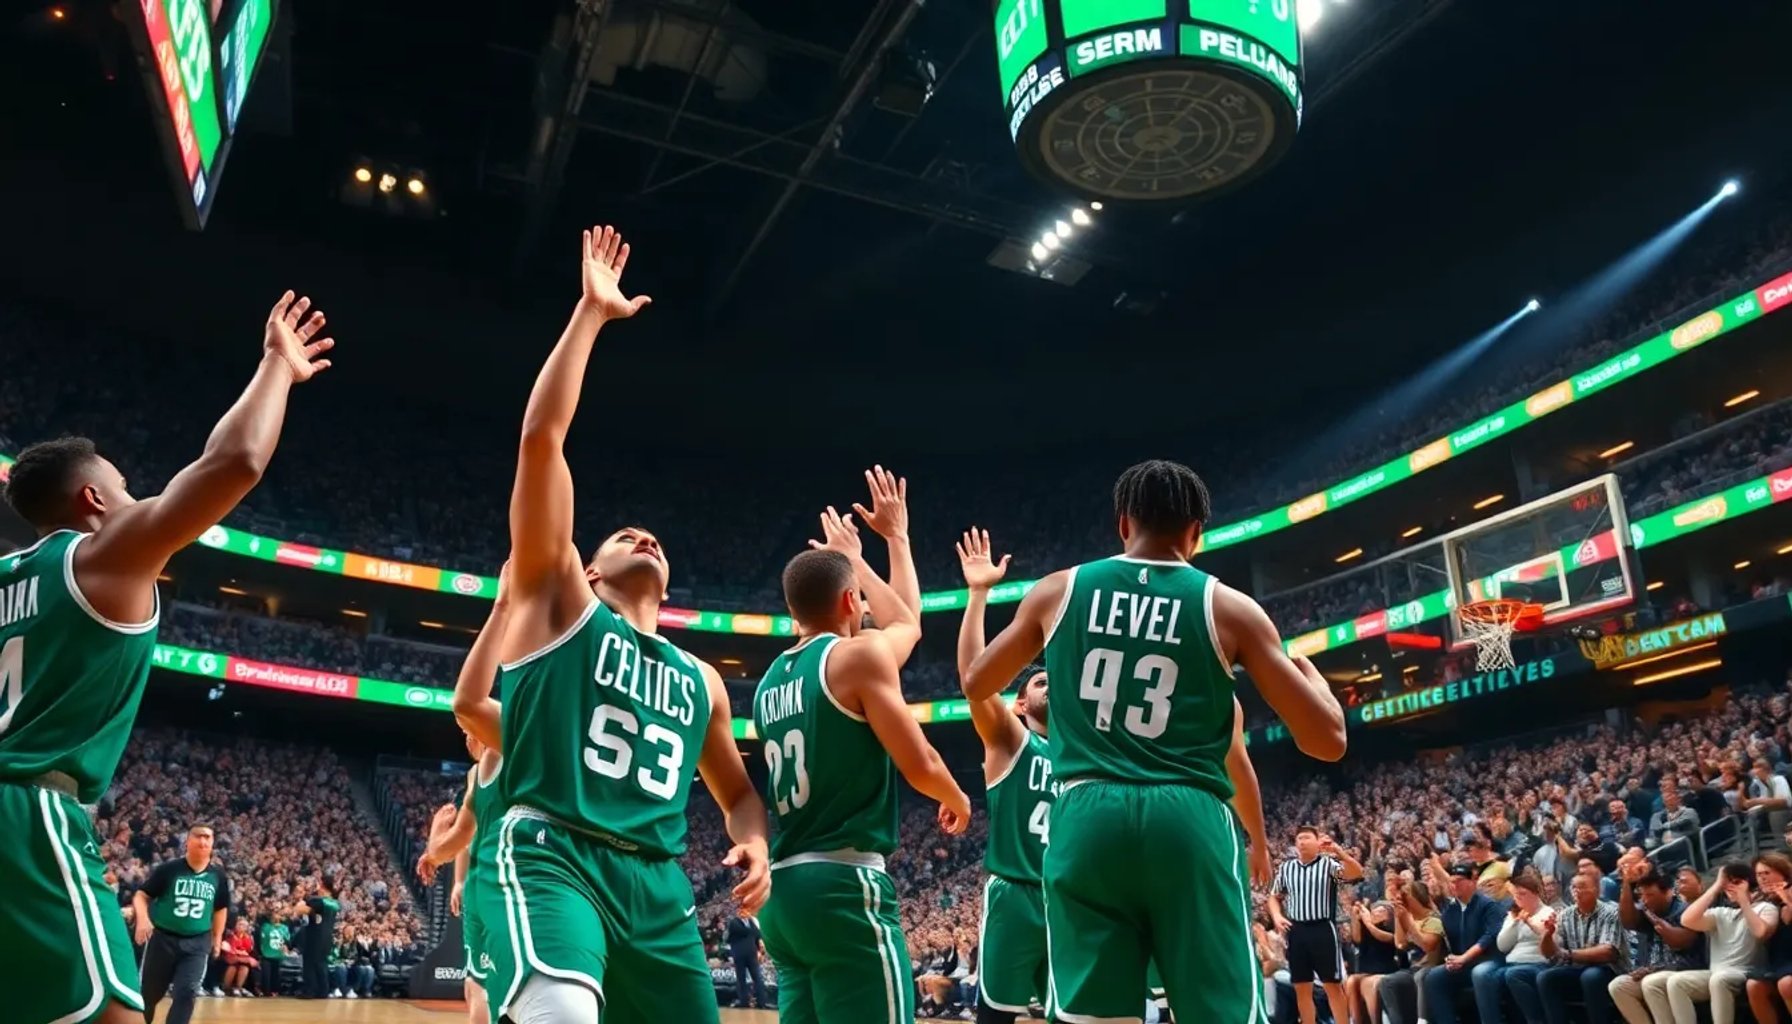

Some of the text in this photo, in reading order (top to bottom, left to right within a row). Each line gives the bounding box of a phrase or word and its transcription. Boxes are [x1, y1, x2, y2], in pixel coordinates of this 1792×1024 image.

[1076, 28, 1162, 65] SERM
[1088, 589, 1182, 645] LEVEL
[594, 632, 696, 727] CELTICS
[1079, 648, 1179, 740] 93
[764, 729, 811, 816] 23
[173, 897, 205, 919] 32
